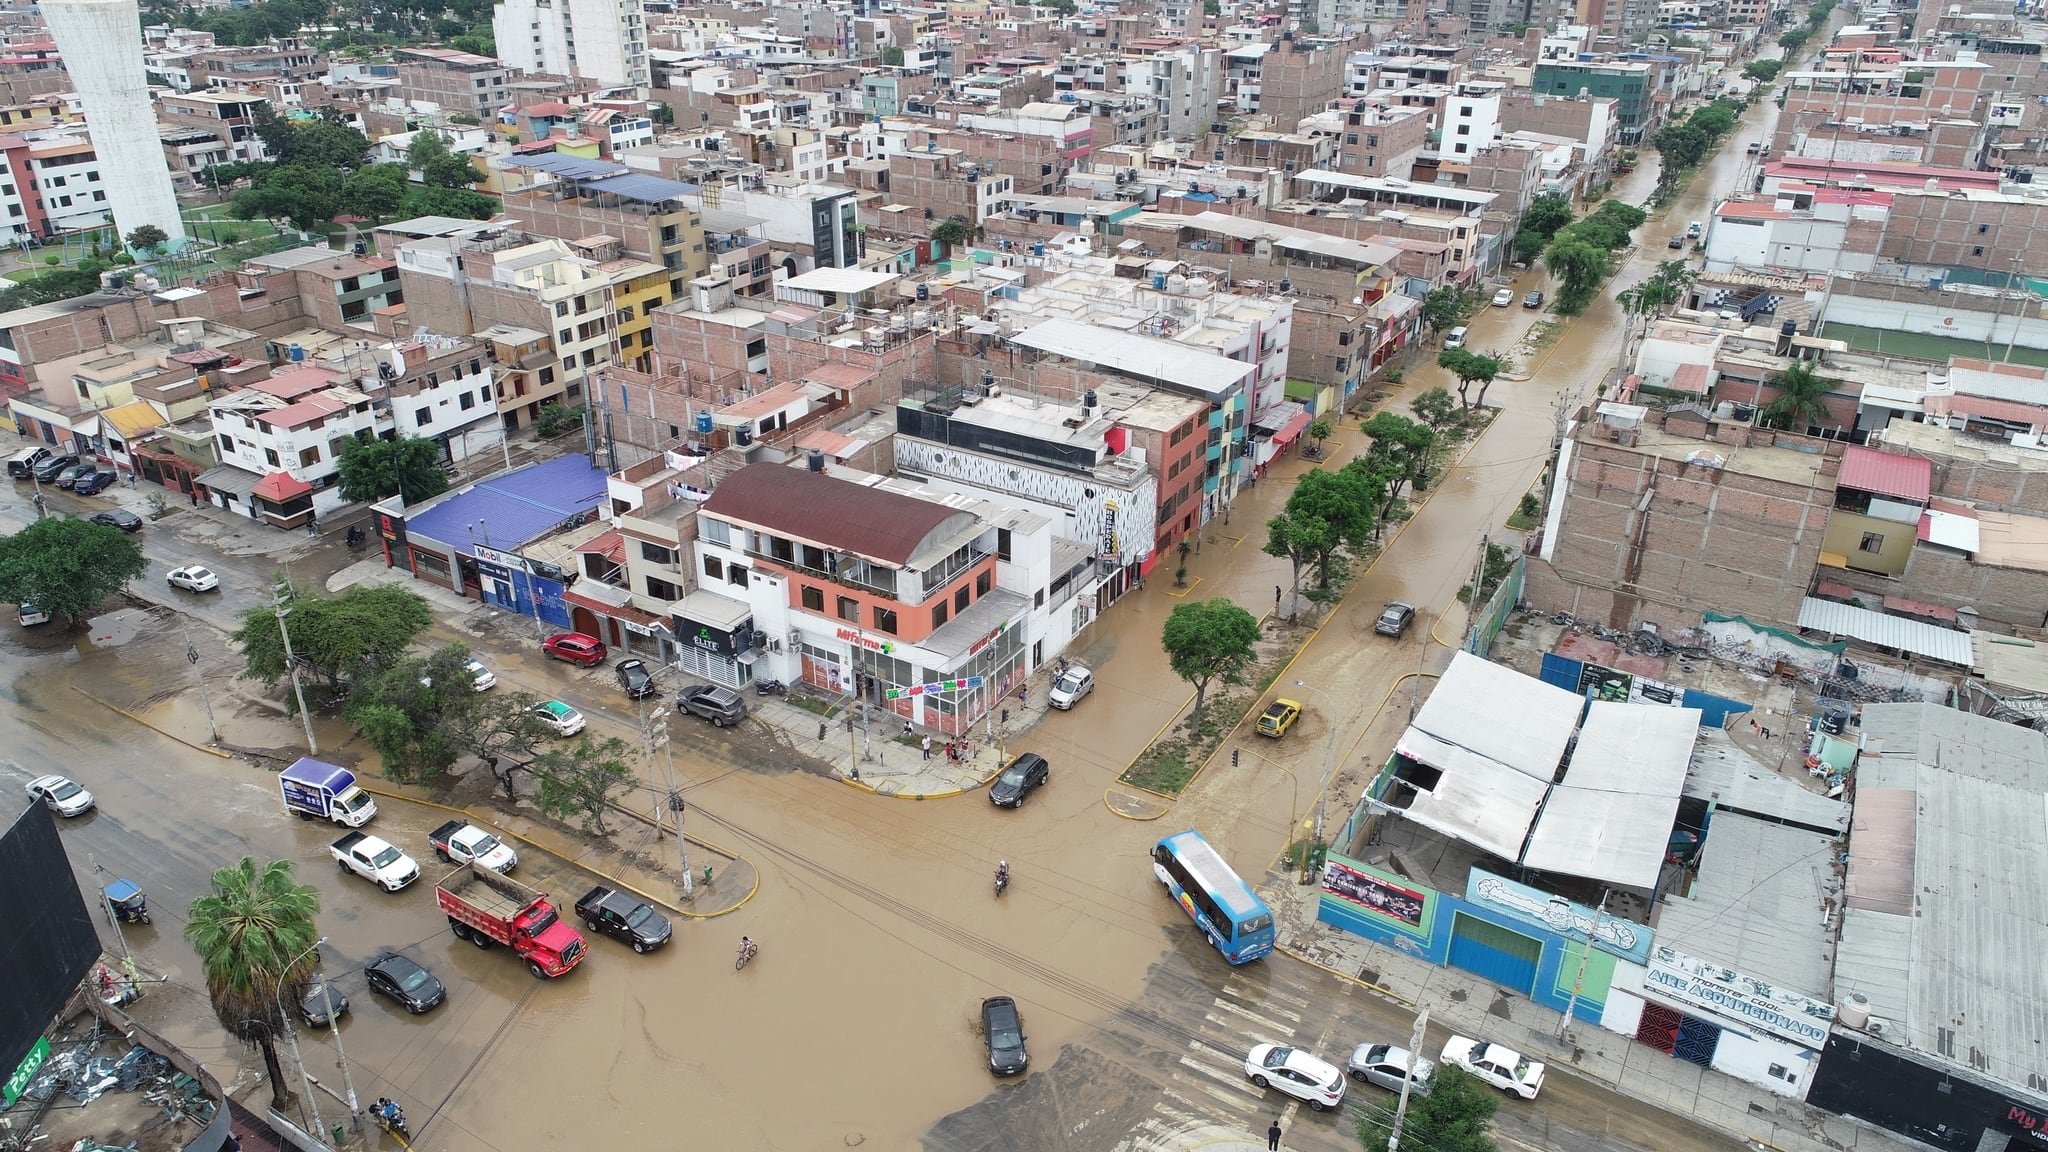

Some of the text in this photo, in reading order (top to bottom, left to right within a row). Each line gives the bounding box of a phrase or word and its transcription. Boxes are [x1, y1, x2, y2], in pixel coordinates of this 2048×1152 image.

[477, 547, 502, 564] Mobil
[694, 635, 718, 649] ELITE
[9, 1047, 42, 1093] Petty
[2007, 1106, 2037, 1129] My
